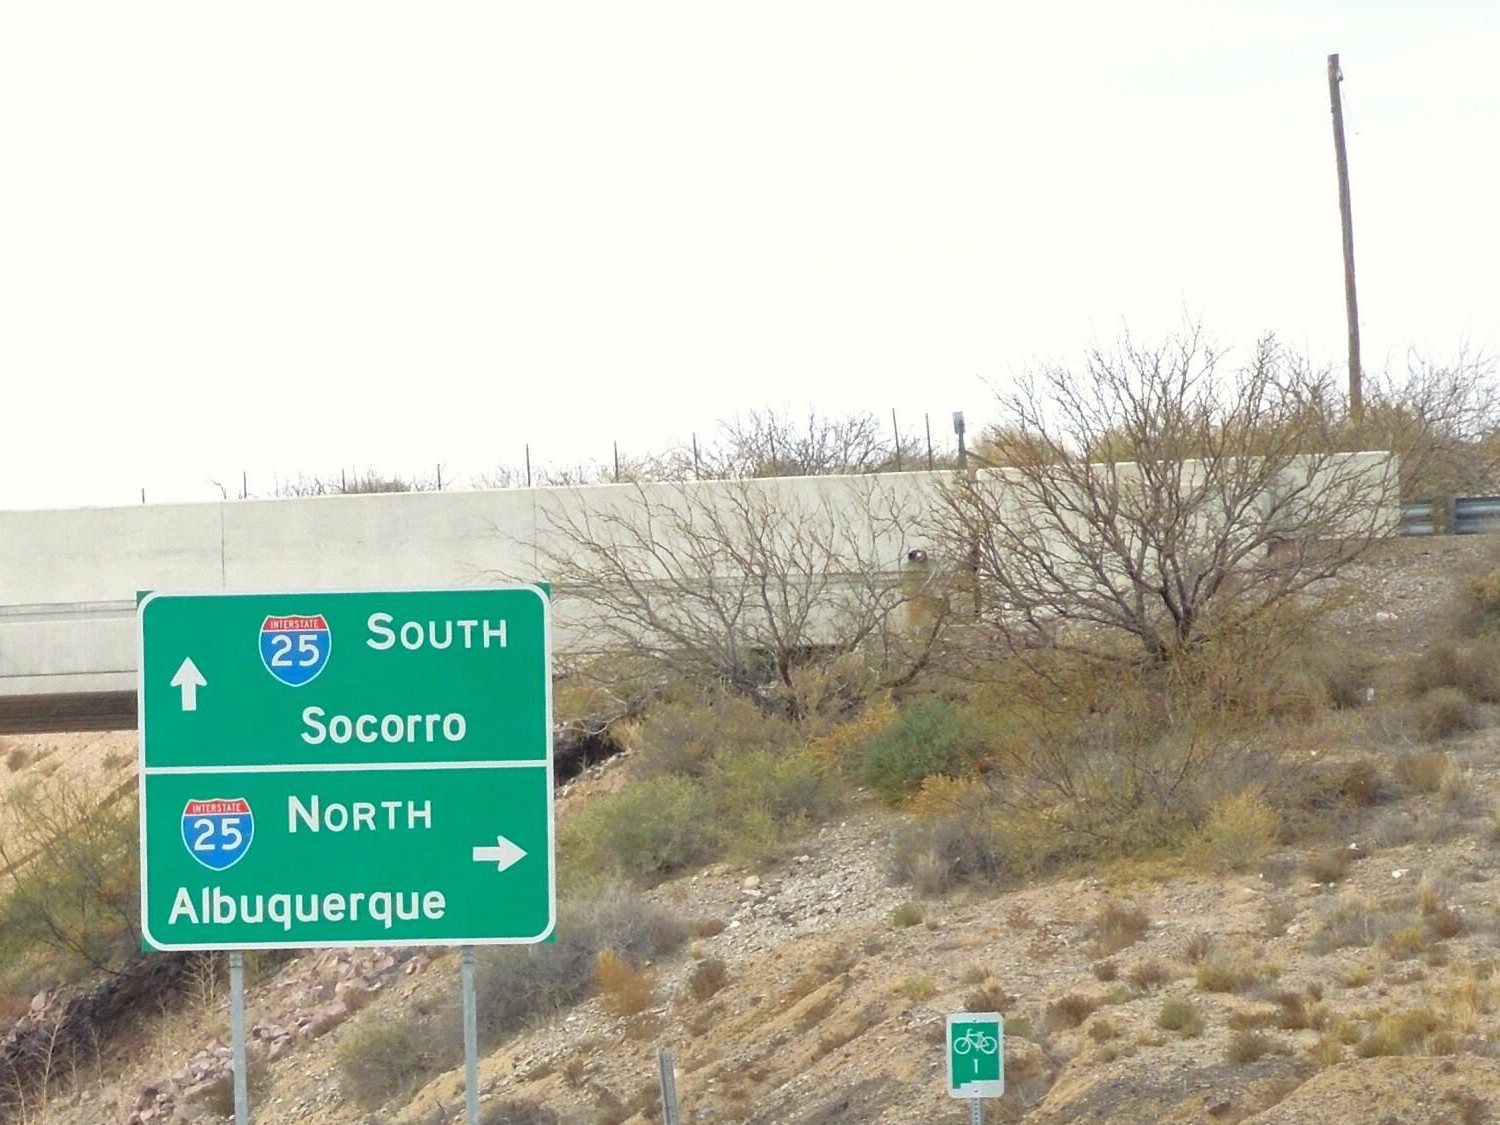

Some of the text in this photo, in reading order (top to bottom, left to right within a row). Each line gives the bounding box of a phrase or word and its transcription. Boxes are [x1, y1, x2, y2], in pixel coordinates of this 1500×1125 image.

[269, 618, 319, 630] INTERSTATE
[270, 612, 507, 667] 25 SOUTH
[300, 705, 466, 744] Socorro
[192, 802, 241, 813] INTERSTATE
[193, 795, 431, 850] 25 NORTH
[168, 885, 446, 931] Albuquerque
[973, 1058, 978, 1074] 1
